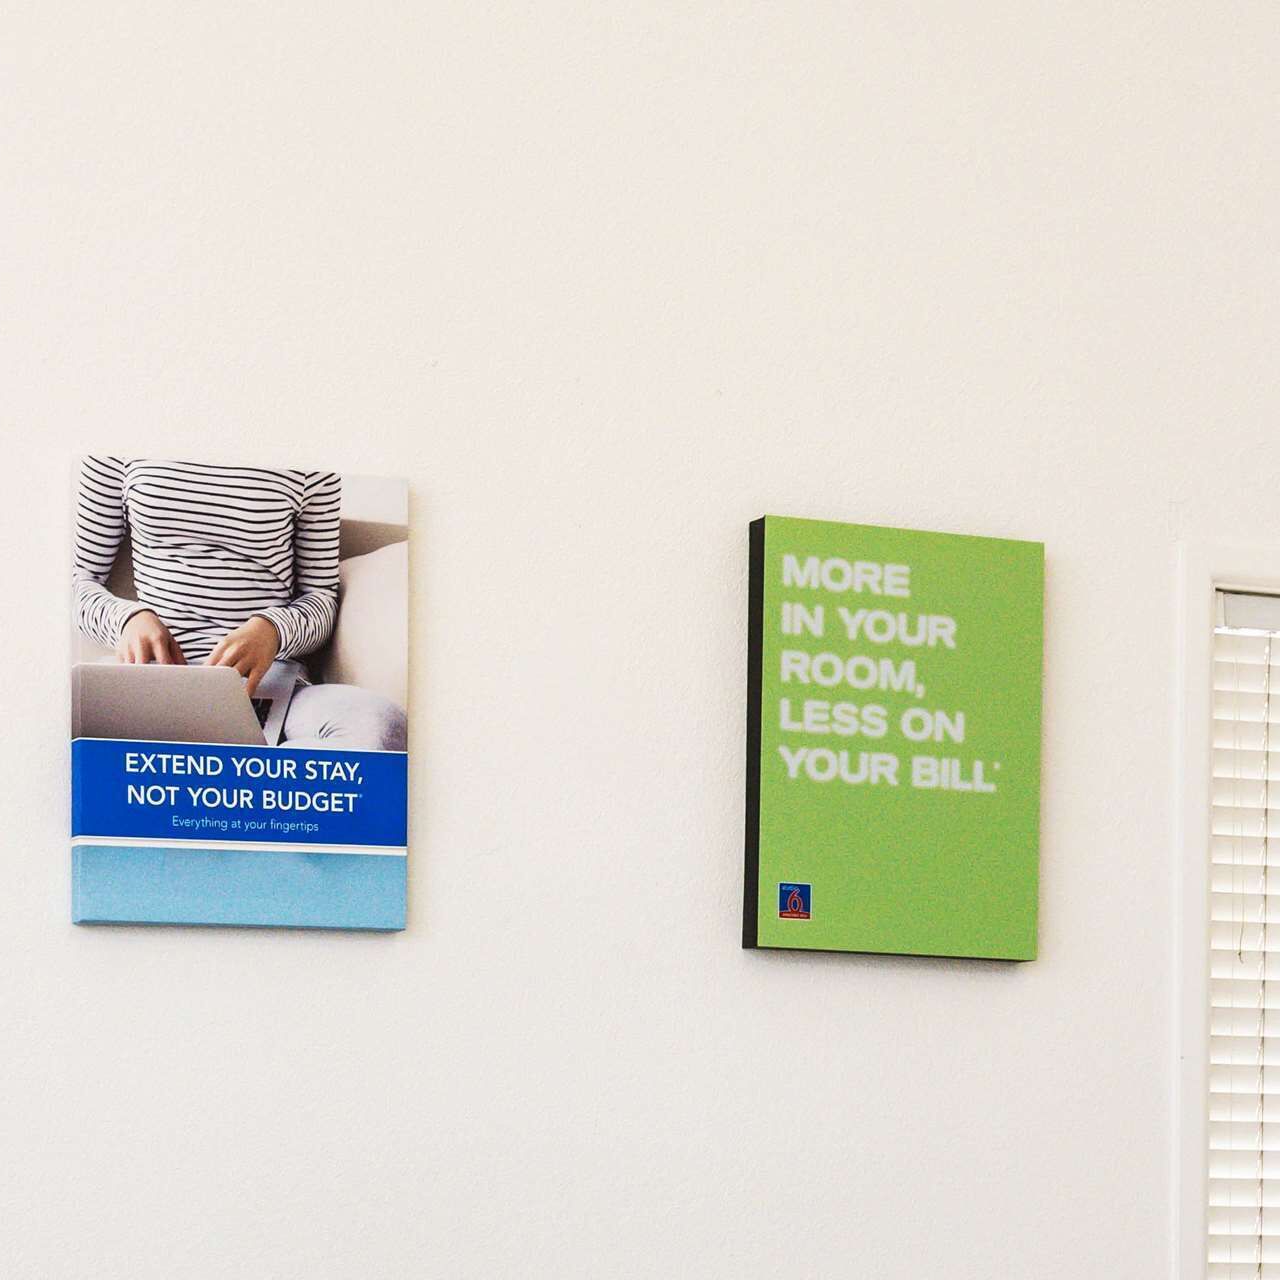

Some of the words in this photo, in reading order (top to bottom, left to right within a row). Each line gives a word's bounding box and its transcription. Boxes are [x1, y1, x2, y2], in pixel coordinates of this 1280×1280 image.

[782, 553, 912, 598] MORE
[780, 601, 825, 637] IN
[837, 606, 958, 650] YOUR
[780, 650, 926, 699] ROOM,
[779, 697, 889, 739] LESS
[899, 706, 966, 744] ON
[125, 752, 224, 777] EXTEND
[231, 757, 297, 780] YOUR
[304, 759, 364, 786] STAY,
[778, 745, 900, 787] YOUR
[127, 784, 180, 806] NOT
[186, 786, 255, 810] YOUR
[172, 815, 228, 832] Everything
[231, 819, 241, 830] at
[243, 821, 268, 833] your
[270, 819, 320, 833] fingertips
